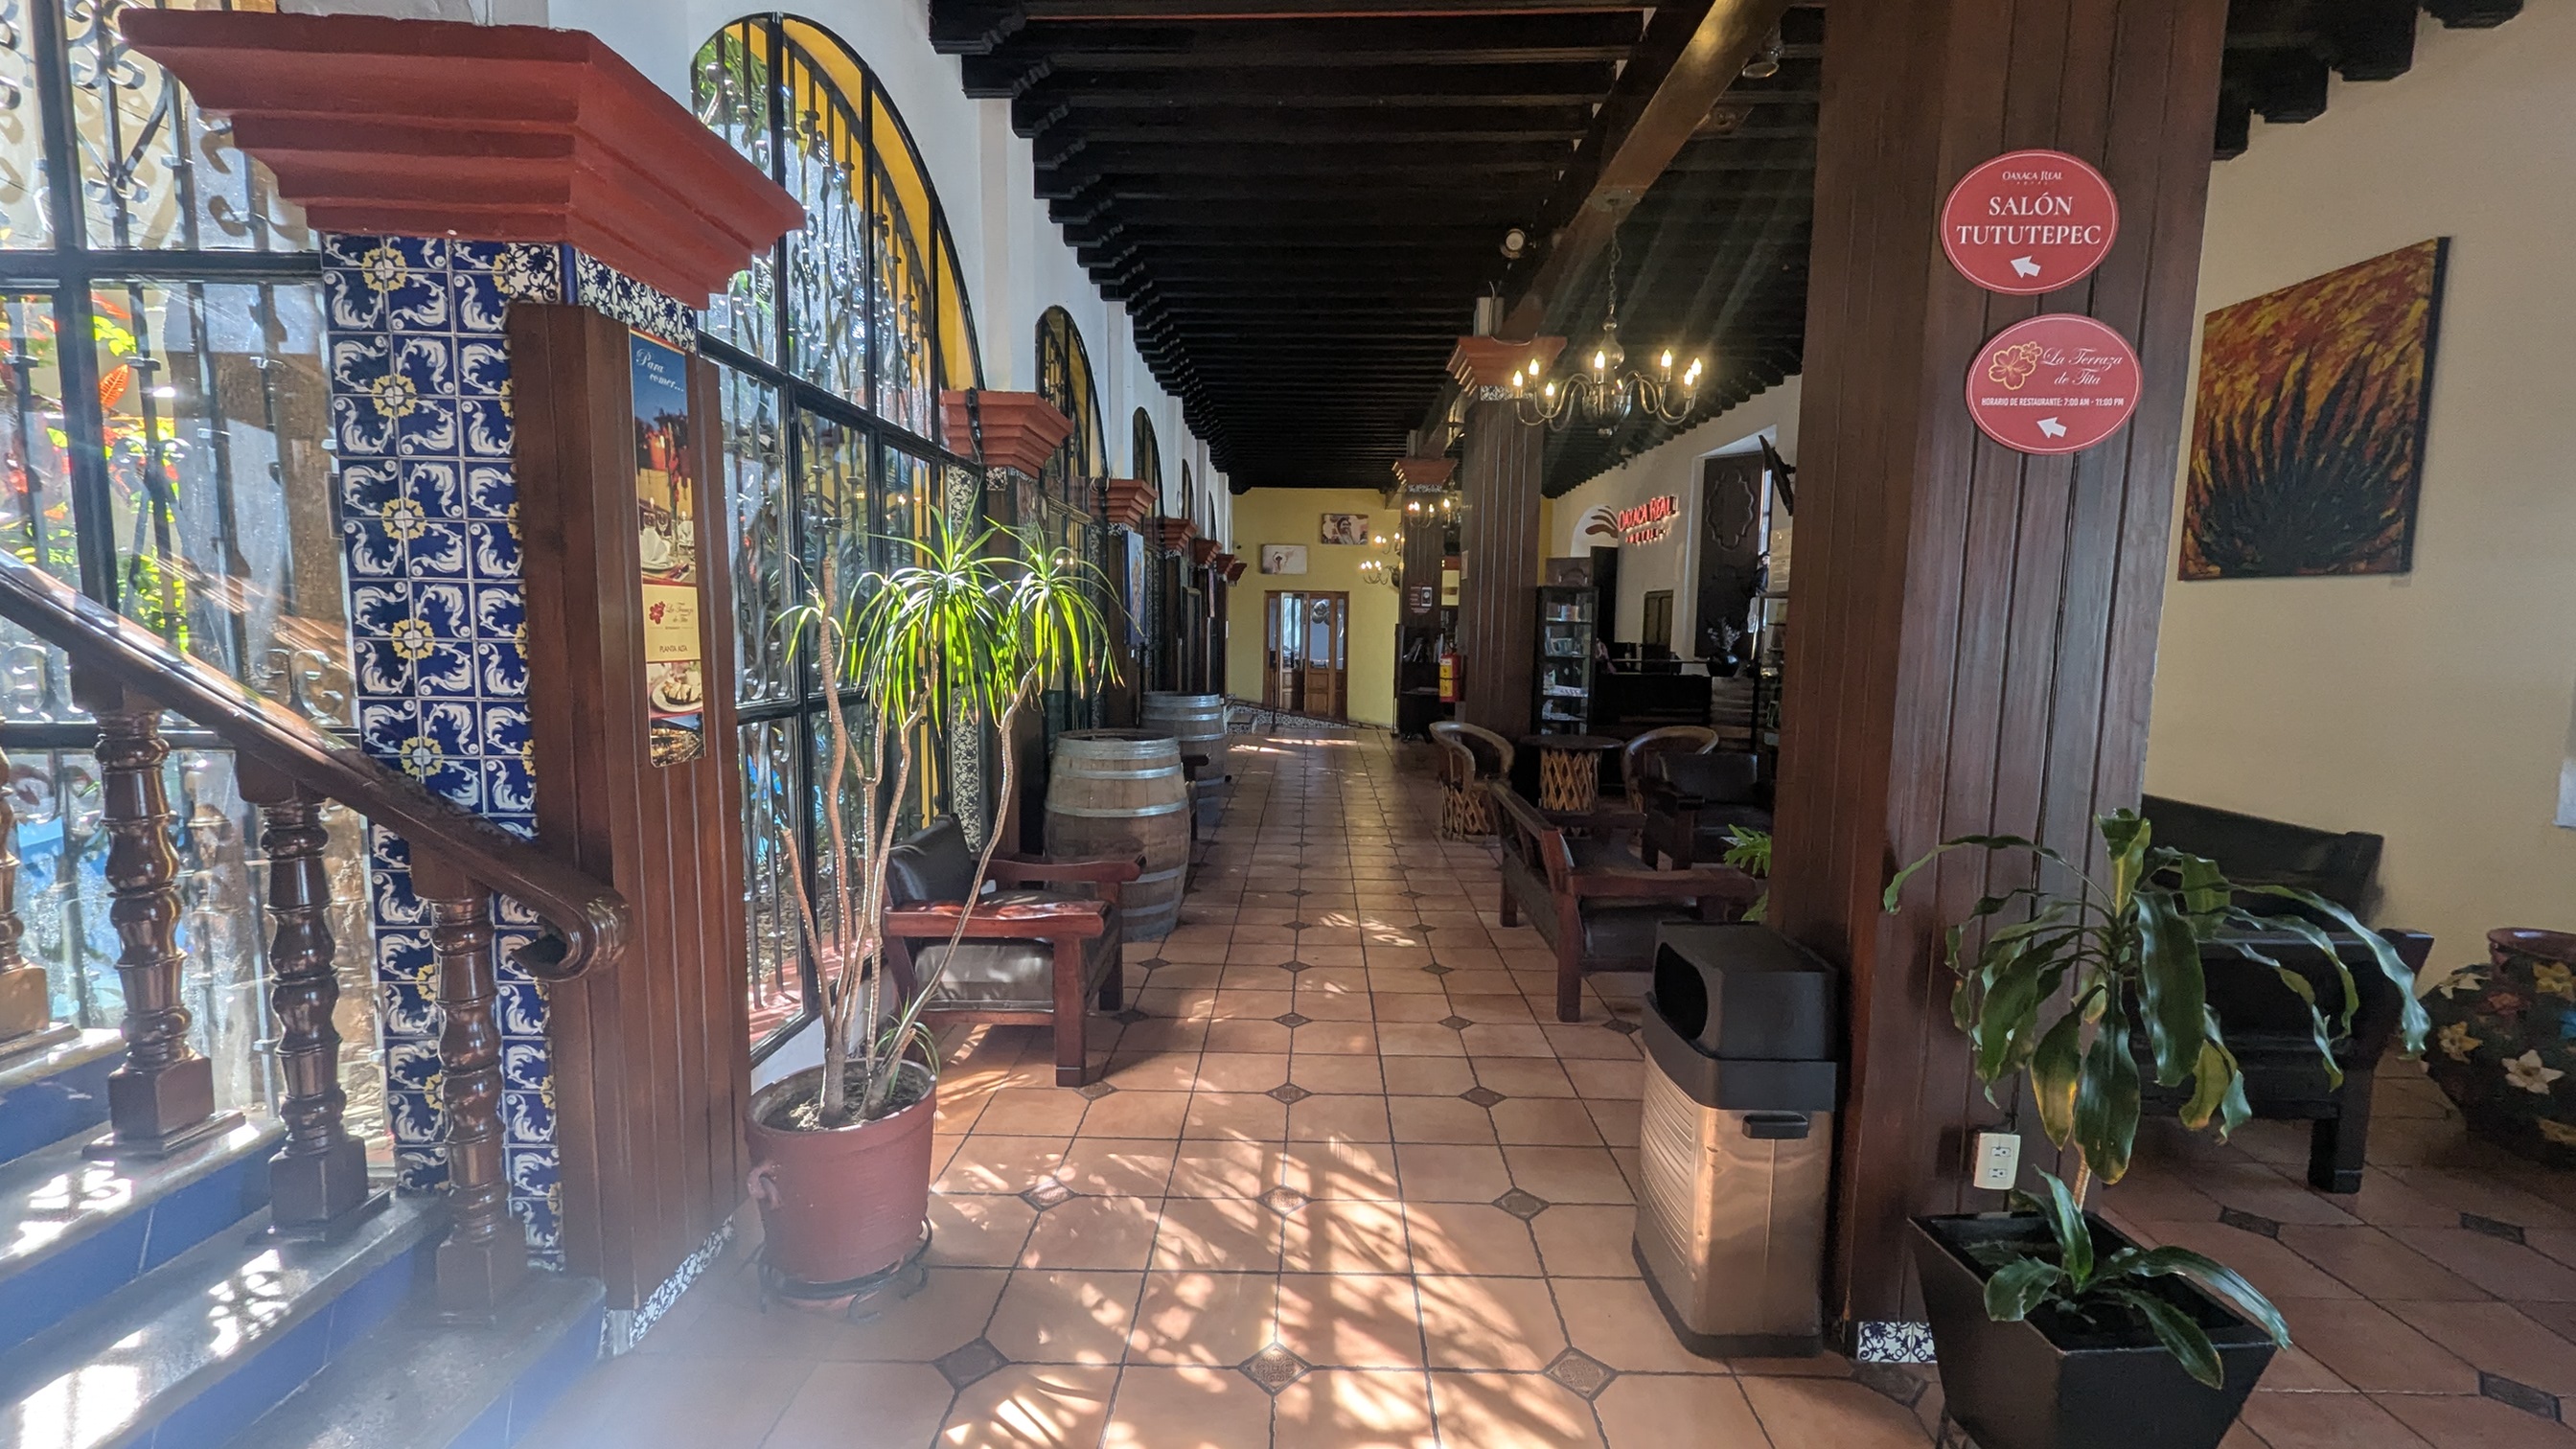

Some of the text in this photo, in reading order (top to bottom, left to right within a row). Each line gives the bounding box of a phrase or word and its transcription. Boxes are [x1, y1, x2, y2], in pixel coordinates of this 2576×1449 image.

[1989, 192, 2073, 216] SALÓN
[1956, 225, 2102, 245] TUTUTEPEC
[635, 348, 665, 373] Para
[2040, 347, 2124, 371] La Terraza
[2054, 368, 2103, 385] de Tita
[1981, 398, 2009, 406] HORARIO
[2010, 398, 2018, 406] DE
[2019, 398, 2063, 406] RESTAURANTE:
[2063, 398, 2079, 406] 7:00
[2080, 398, 2090, 406] AM
[2096, 398, 2113, 406] 11:00
[2113, 398, 2125, 406] PM
